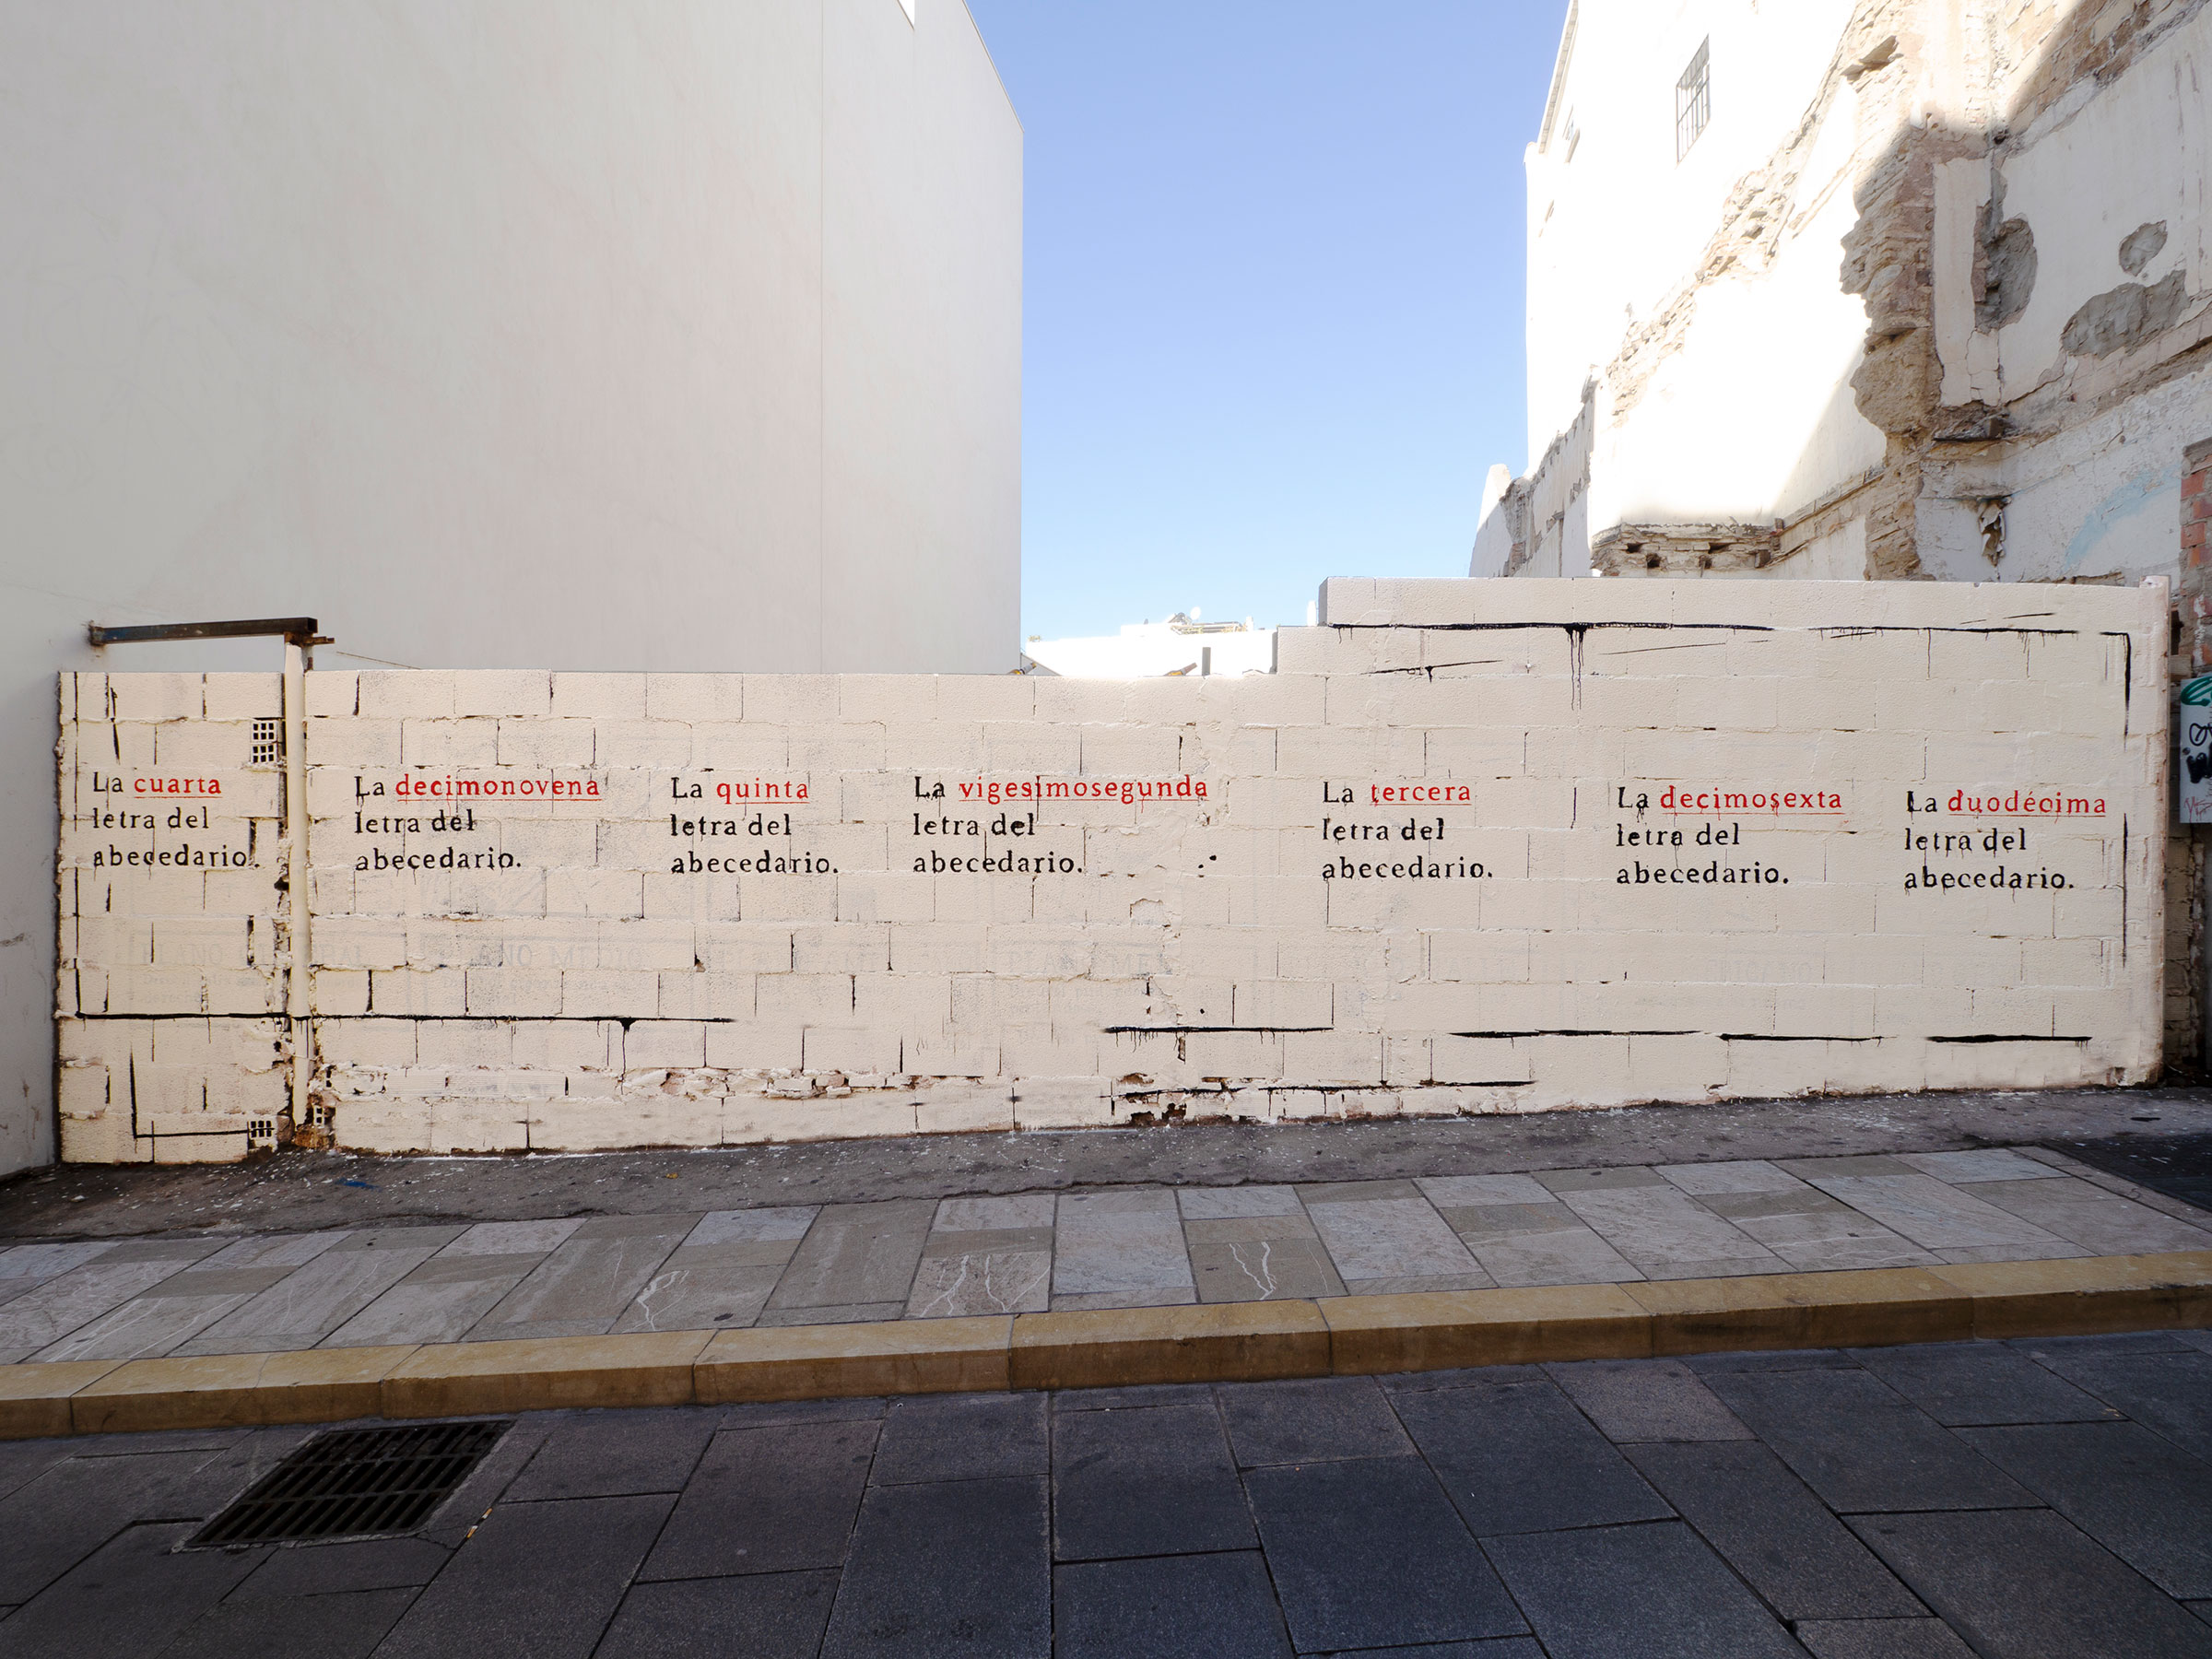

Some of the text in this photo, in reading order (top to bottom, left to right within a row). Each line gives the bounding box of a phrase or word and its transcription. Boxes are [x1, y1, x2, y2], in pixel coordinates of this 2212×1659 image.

[93, 771, 222, 794] La cuarta
[354, 773, 600, 798] La decimonovena
[670, 776, 809, 806] La quinta
[914, 774, 1208, 806] La vigesimosegunda
[1323, 781, 1471, 804] La tercera
[1618, 784, 1842, 810] La decimosexta
[1906, 788, 2106, 815] La duodécima
[91, 806, 209, 830] letra del
[354, 808, 476, 834] letra del
[670, 813, 792, 837] letra del
[912, 812, 1035, 837] letra del
[1323, 817, 1444, 841] letra del
[1616, 822, 1740, 847] letra del
[1904, 827, 2027, 852] letra del
[93, 843, 260, 868] abecedario.
[355, 846, 523, 871] abecedario.
[670, 849, 839, 875] abecedario.
[912, 850, 1083, 874] abecedario.
[1322, 854, 1493, 879] abecedario.
[1617, 860, 1790, 885] abecedario.
[1904, 865, 2075, 889] abecedario.
